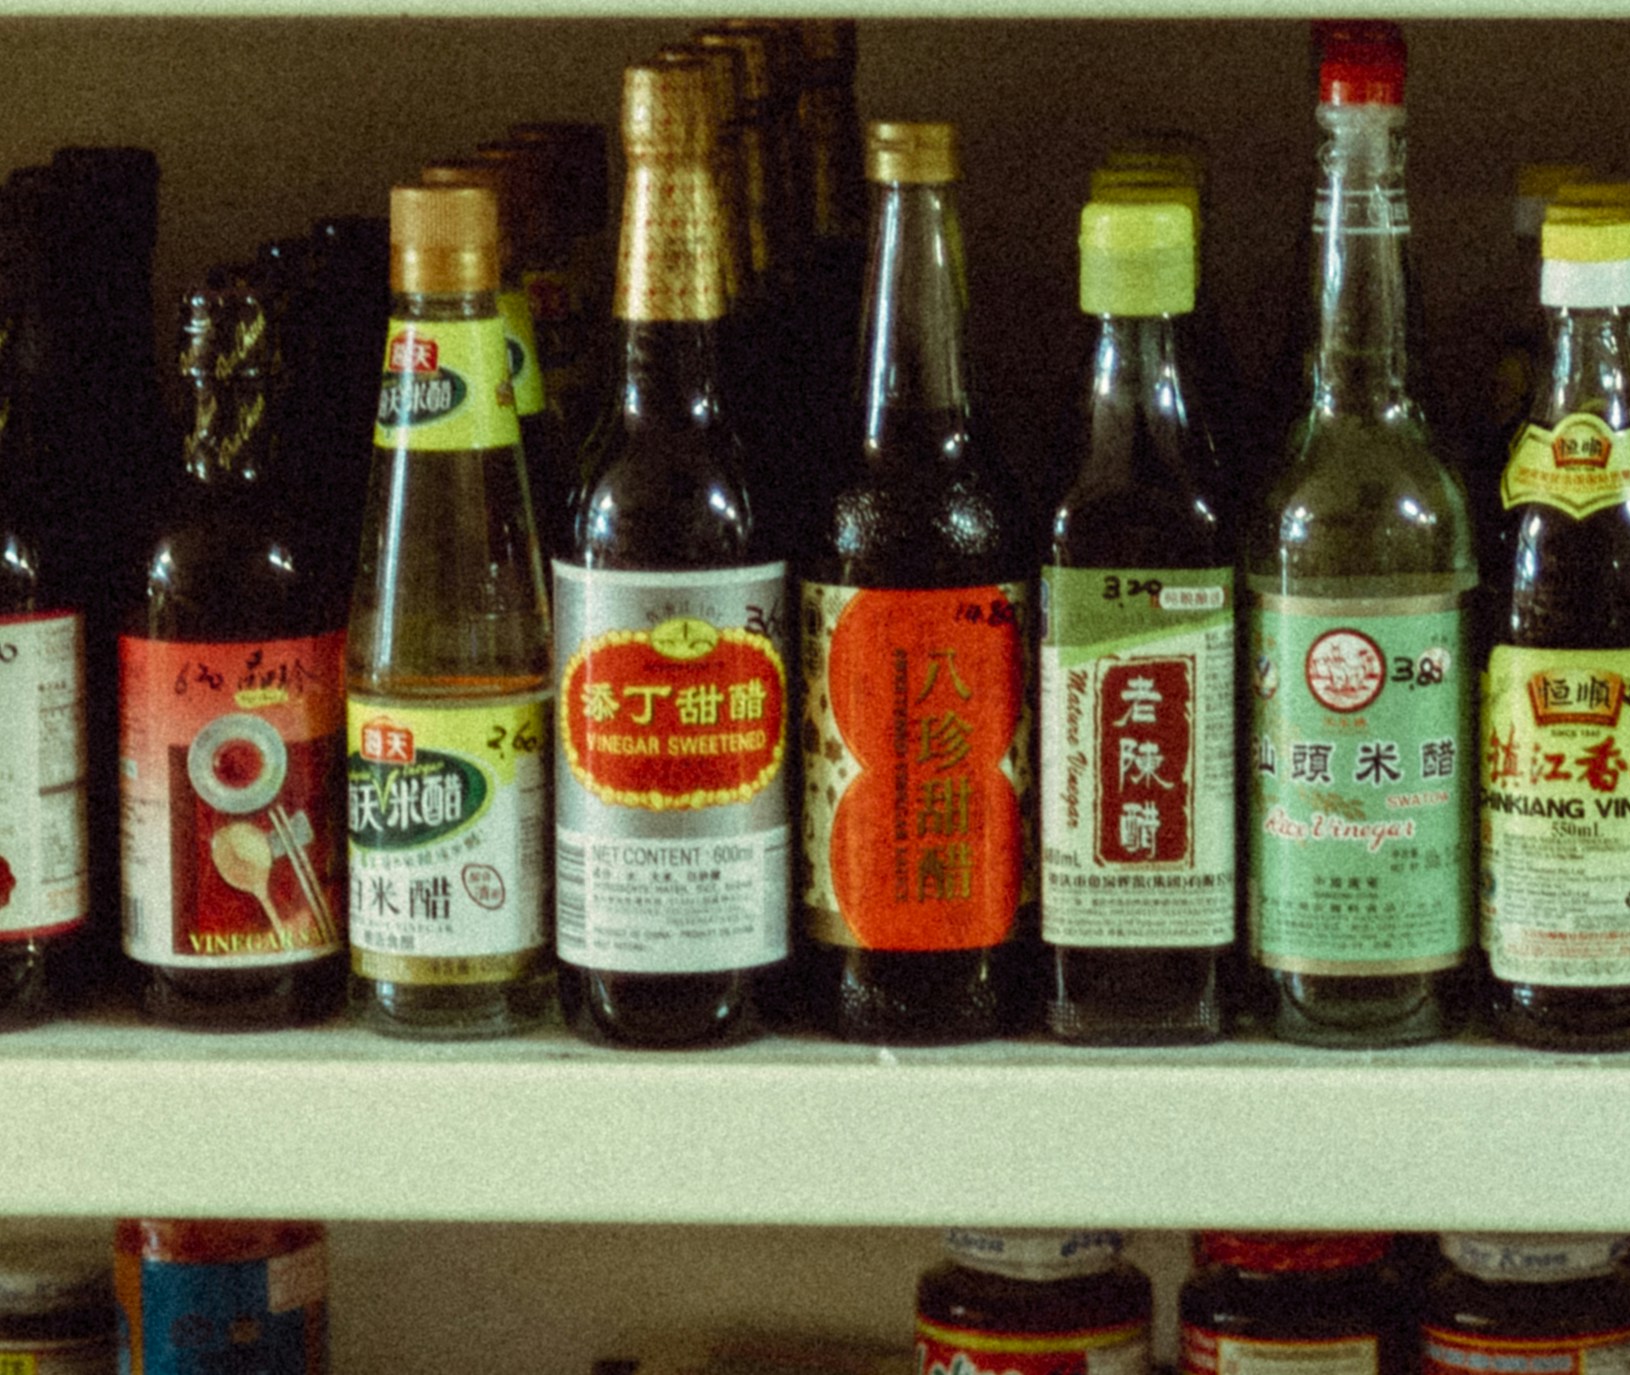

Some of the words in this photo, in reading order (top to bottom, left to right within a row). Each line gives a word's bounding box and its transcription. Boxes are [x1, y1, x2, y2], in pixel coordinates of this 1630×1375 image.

[580, 677, 768, 726] 添丁甜醋
[584, 731, 661, 756] VINEGAR
[668, 727, 768, 757] SWEETENED
[915, 646, 975, 904] 八珍甜醋
[1112, 673, 1176, 862] 老陳醋
[1311, 808, 1417, 852] Vinegar
[1551, 819, 1605, 838] 550mL
[622, 846, 701, 868] CONTENT
